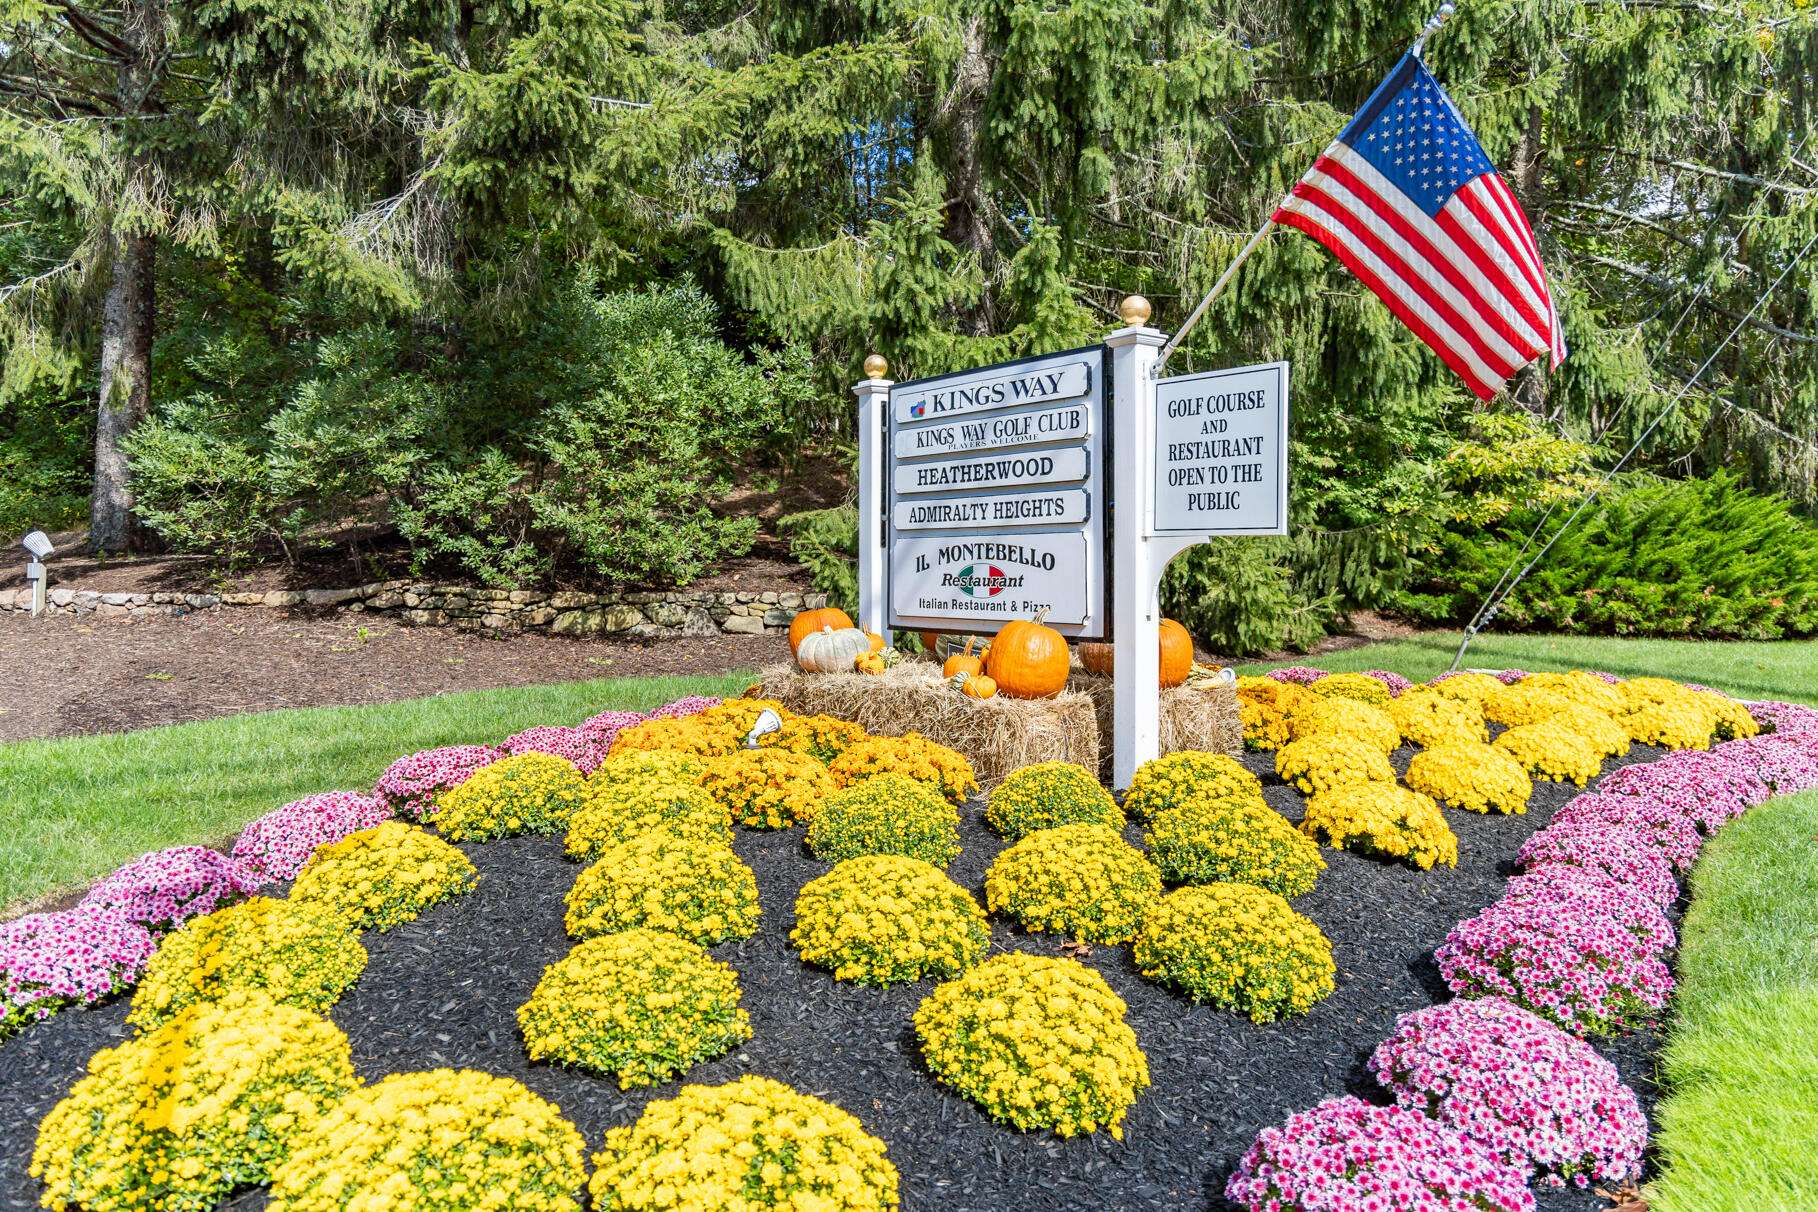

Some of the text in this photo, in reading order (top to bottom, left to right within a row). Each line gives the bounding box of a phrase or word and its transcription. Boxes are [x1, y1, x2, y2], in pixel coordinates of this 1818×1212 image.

[933, 371, 1066, 412] KINGS WAY
[1168, 390, 1265, 418] GOLF COURSE
[916, 410, 1080, 448] KINGS WAY GOLF CLUB
[1200, 418, 1228, 434] AND
[948, 433, 1039, 450] PLAYERS WELCOME
[1168, 436, 1264, 461] RESTAURANT
[917, 456, 1053, 486] HEATHERWOOD
[1168, 463, 1263, 486] OPEN TO THE
[909, 497, 1064, 523] ADMIRALTY HEIGHTS
[1188, 491, 1240, 511] PUBLIC
[915, 543, 1055, 573] IL MONTEBELLO
[941, 572, 1024, 588] Restaurant
[919, 598, 948, 610] Italian
[951, 599, 1006, 612] Restaurant
[1010, 600, 1018, 612] &
